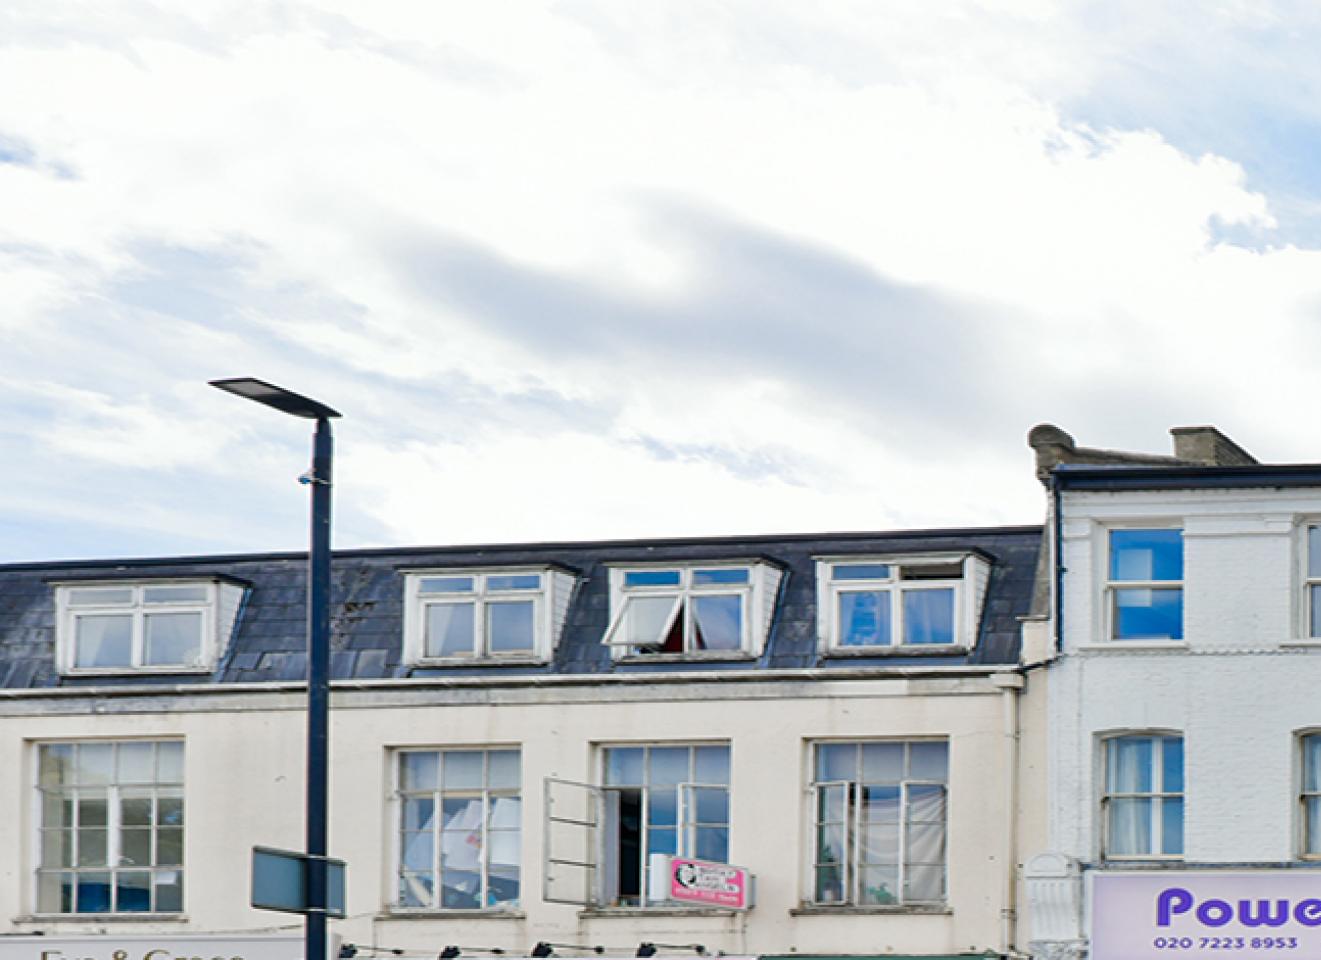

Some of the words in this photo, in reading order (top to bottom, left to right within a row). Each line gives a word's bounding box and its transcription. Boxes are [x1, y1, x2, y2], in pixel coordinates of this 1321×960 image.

[1153, 936, 1193, 949] 020
[1198, 936, 1245, 949] 7223
[1250, 936, 1299, 949] 8953
